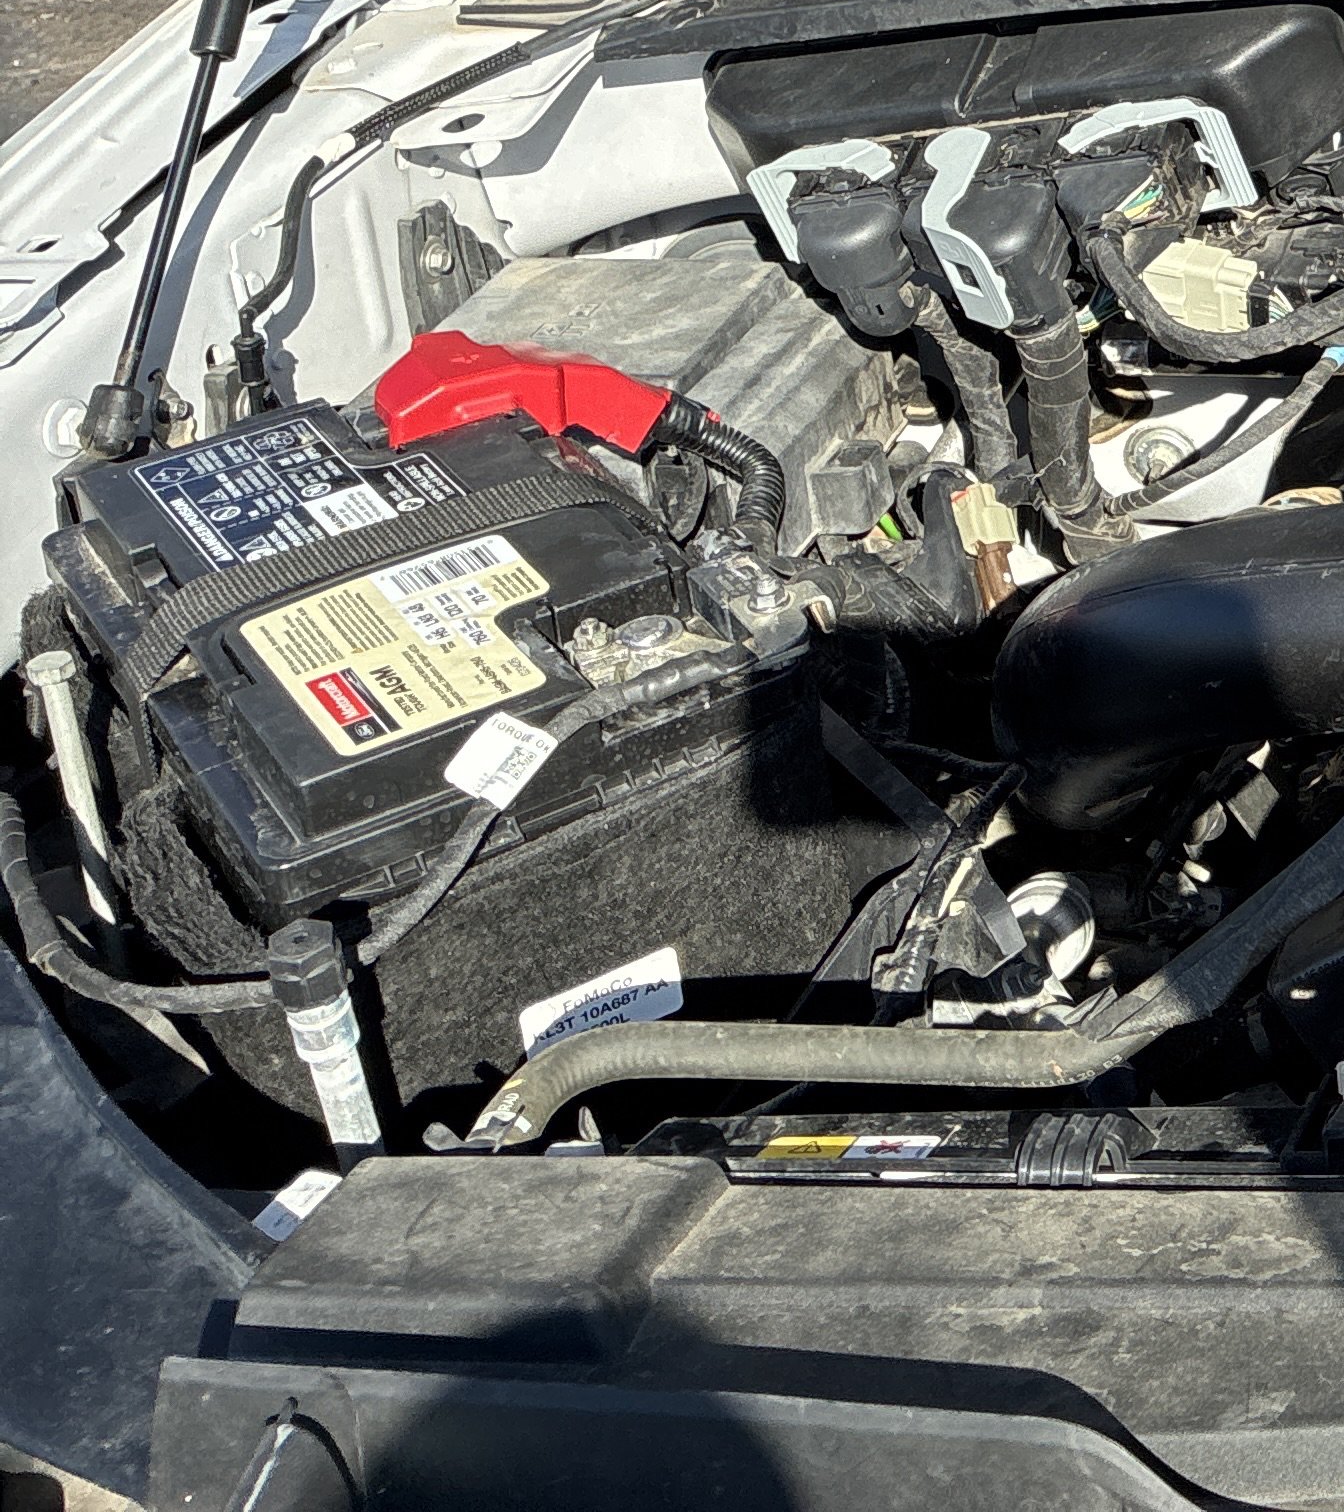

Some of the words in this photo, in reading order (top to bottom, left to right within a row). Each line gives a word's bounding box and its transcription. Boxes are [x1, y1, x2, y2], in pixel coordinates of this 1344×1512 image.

[314, 676, 360, 720] Motorcraft
[368, 663, 411, 698] AGM
[533, 1015, 576, 1044] KL3T
[580, 988, 639, 1023] 10A687
[644, 978, 668, 995] AA
[563, 977, 633, 1013] FoMoCo
